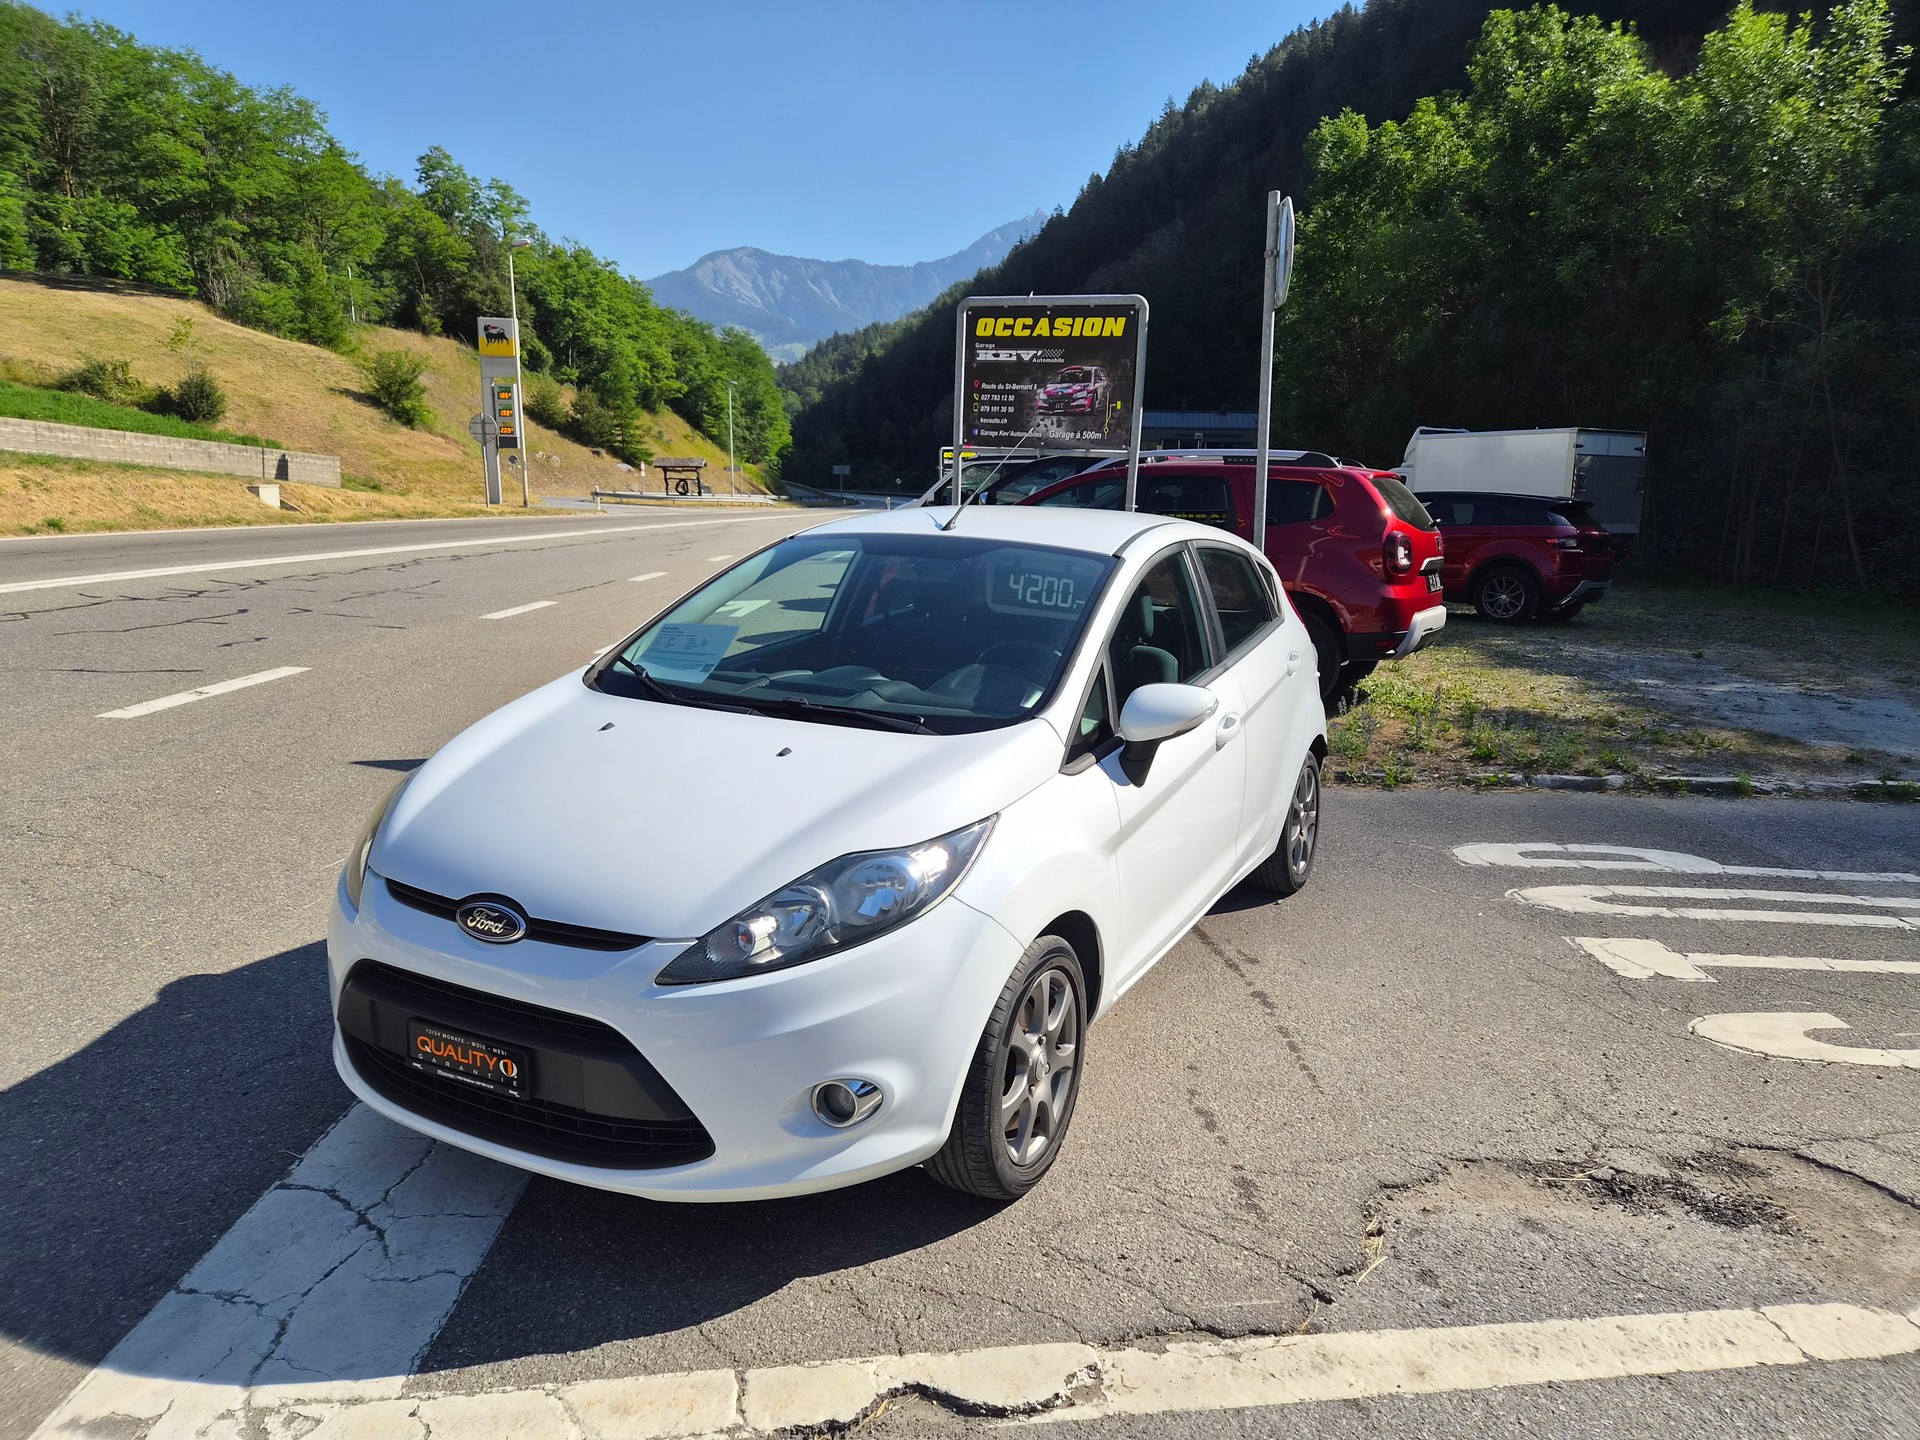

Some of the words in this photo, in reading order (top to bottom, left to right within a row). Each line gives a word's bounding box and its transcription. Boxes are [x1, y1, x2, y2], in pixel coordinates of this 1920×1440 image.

[975, 317, 1127, 337] OCCASION
[981, 382, 996, 390] Route
[980, 430, 998, 438] Garage
[1049, 430, 1074, 441] Garage
[1076, 431, 1081, 439] à
[1082, 432, 1102, 440] 500m
[467, 907, 511, 934] Ford
[417, 1035, 498, 1071] QUALITY
[442, 1033, 465, 1044] MONATE
[471, 1041, 486, 1050] MOIS
[492, 1047, 507, 1056] MESI
[418, 1053, 518, 1087] GARANTIE
